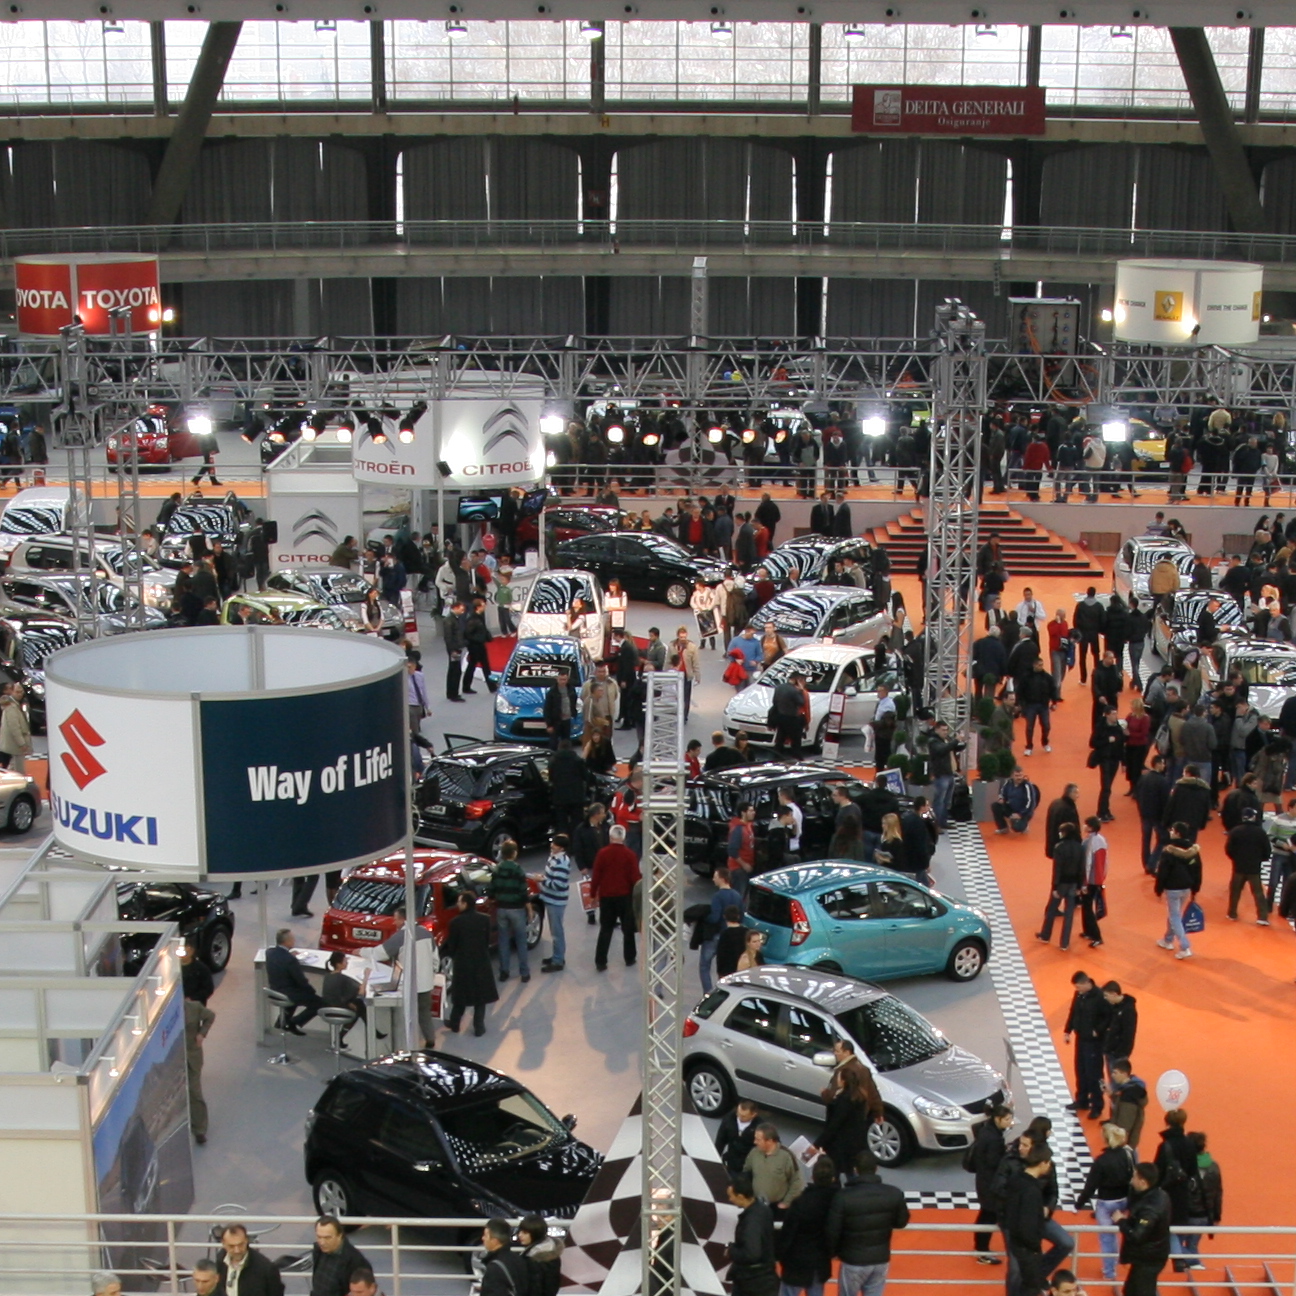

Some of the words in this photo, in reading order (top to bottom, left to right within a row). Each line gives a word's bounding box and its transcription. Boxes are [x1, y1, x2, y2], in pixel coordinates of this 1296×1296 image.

[905, 101, 948, 115] DELTA
[953, 101, 1025, 116] GENERALI
[937, 117, 991, 128] Osiguranje
[16, 289, 69, 309] OYOTA
[82, 285, 158, 310] TOYOTA
[462, 457, 535, 477] CITROË
[278, 553, 332, 563] CITRO
[247, 764, 312, 805] Way
[321, 755, 348, 794] of
[354, 742, 393, 788] Life!
